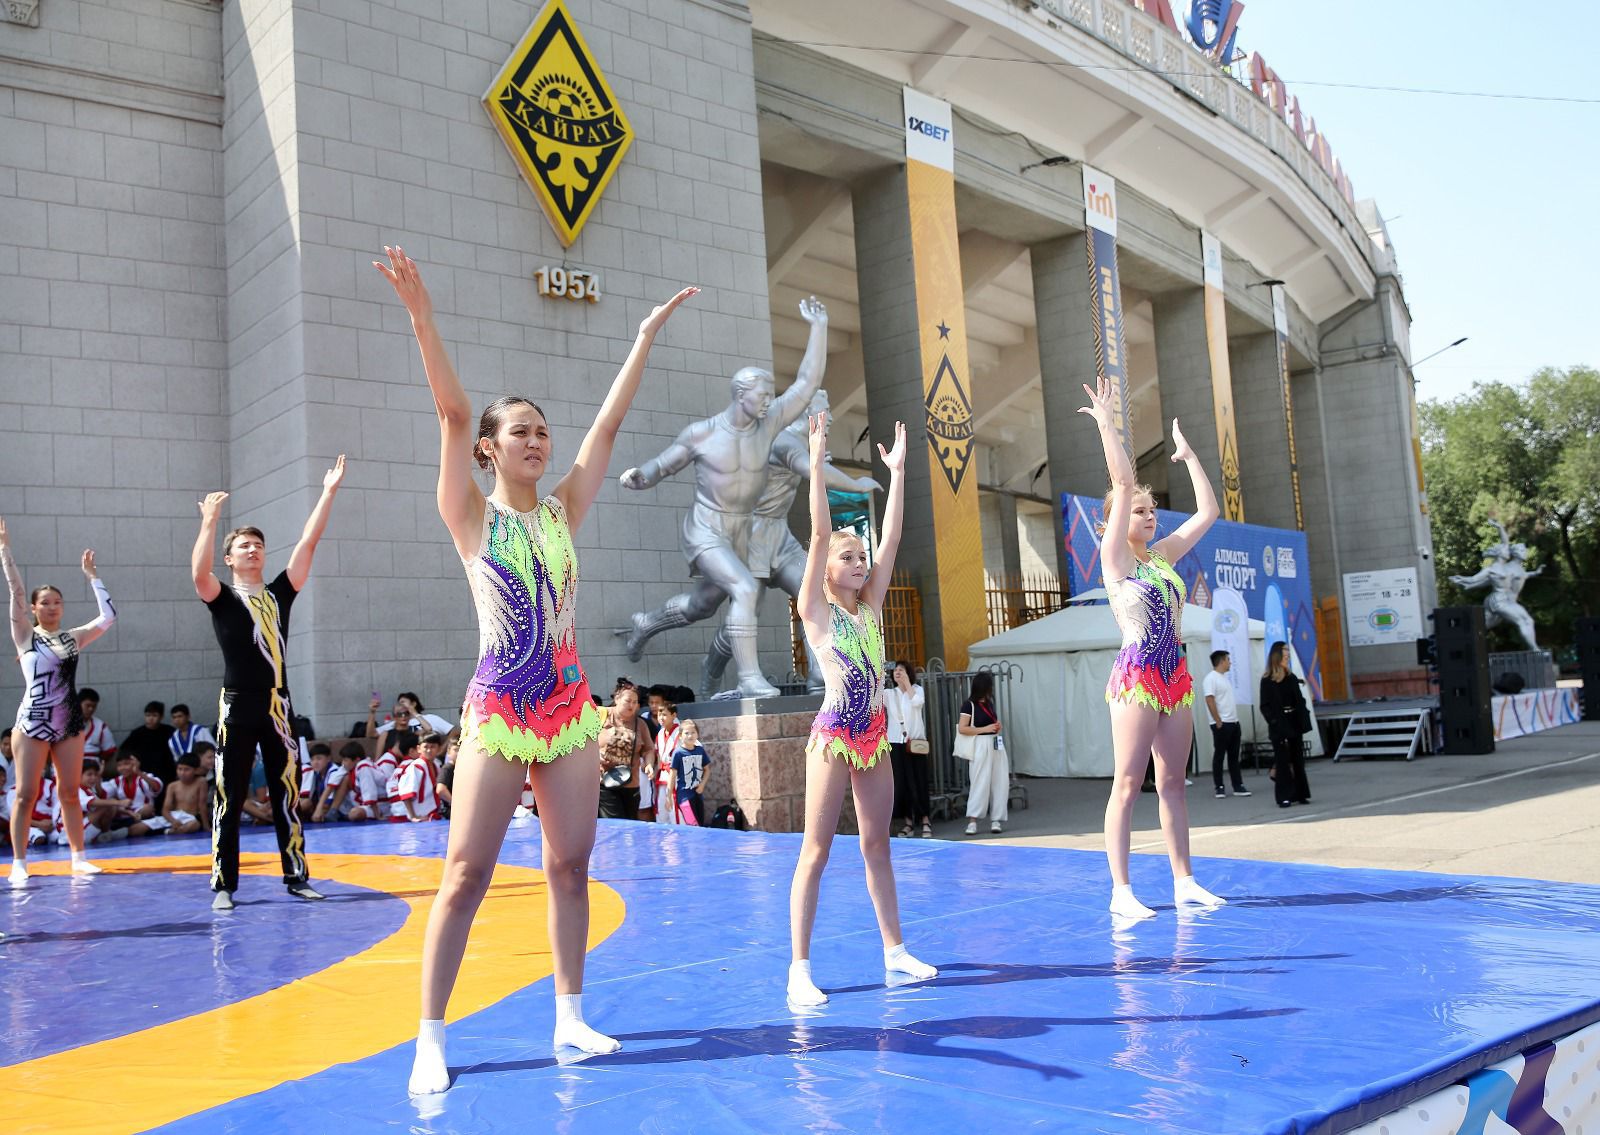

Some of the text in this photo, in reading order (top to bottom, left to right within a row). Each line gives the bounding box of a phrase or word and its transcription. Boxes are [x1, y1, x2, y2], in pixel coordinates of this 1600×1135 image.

[515, 101, 612, 144] КАЙРАТ
[909, 116, 950, 142] 1XBET
[535, 264, 602, 304] 1954
[1100, 266, 1119, 367] КЛУБЫ
[926, 415, 974, 438] КАЙРАТ
[1215, 548, 1249, 566] АЛМАТЫ
[1215, 564, 1256, 590] СПОРТ
[1382, 590, 1391, 598] 18
[1400, 589, 1411, 597] 28
